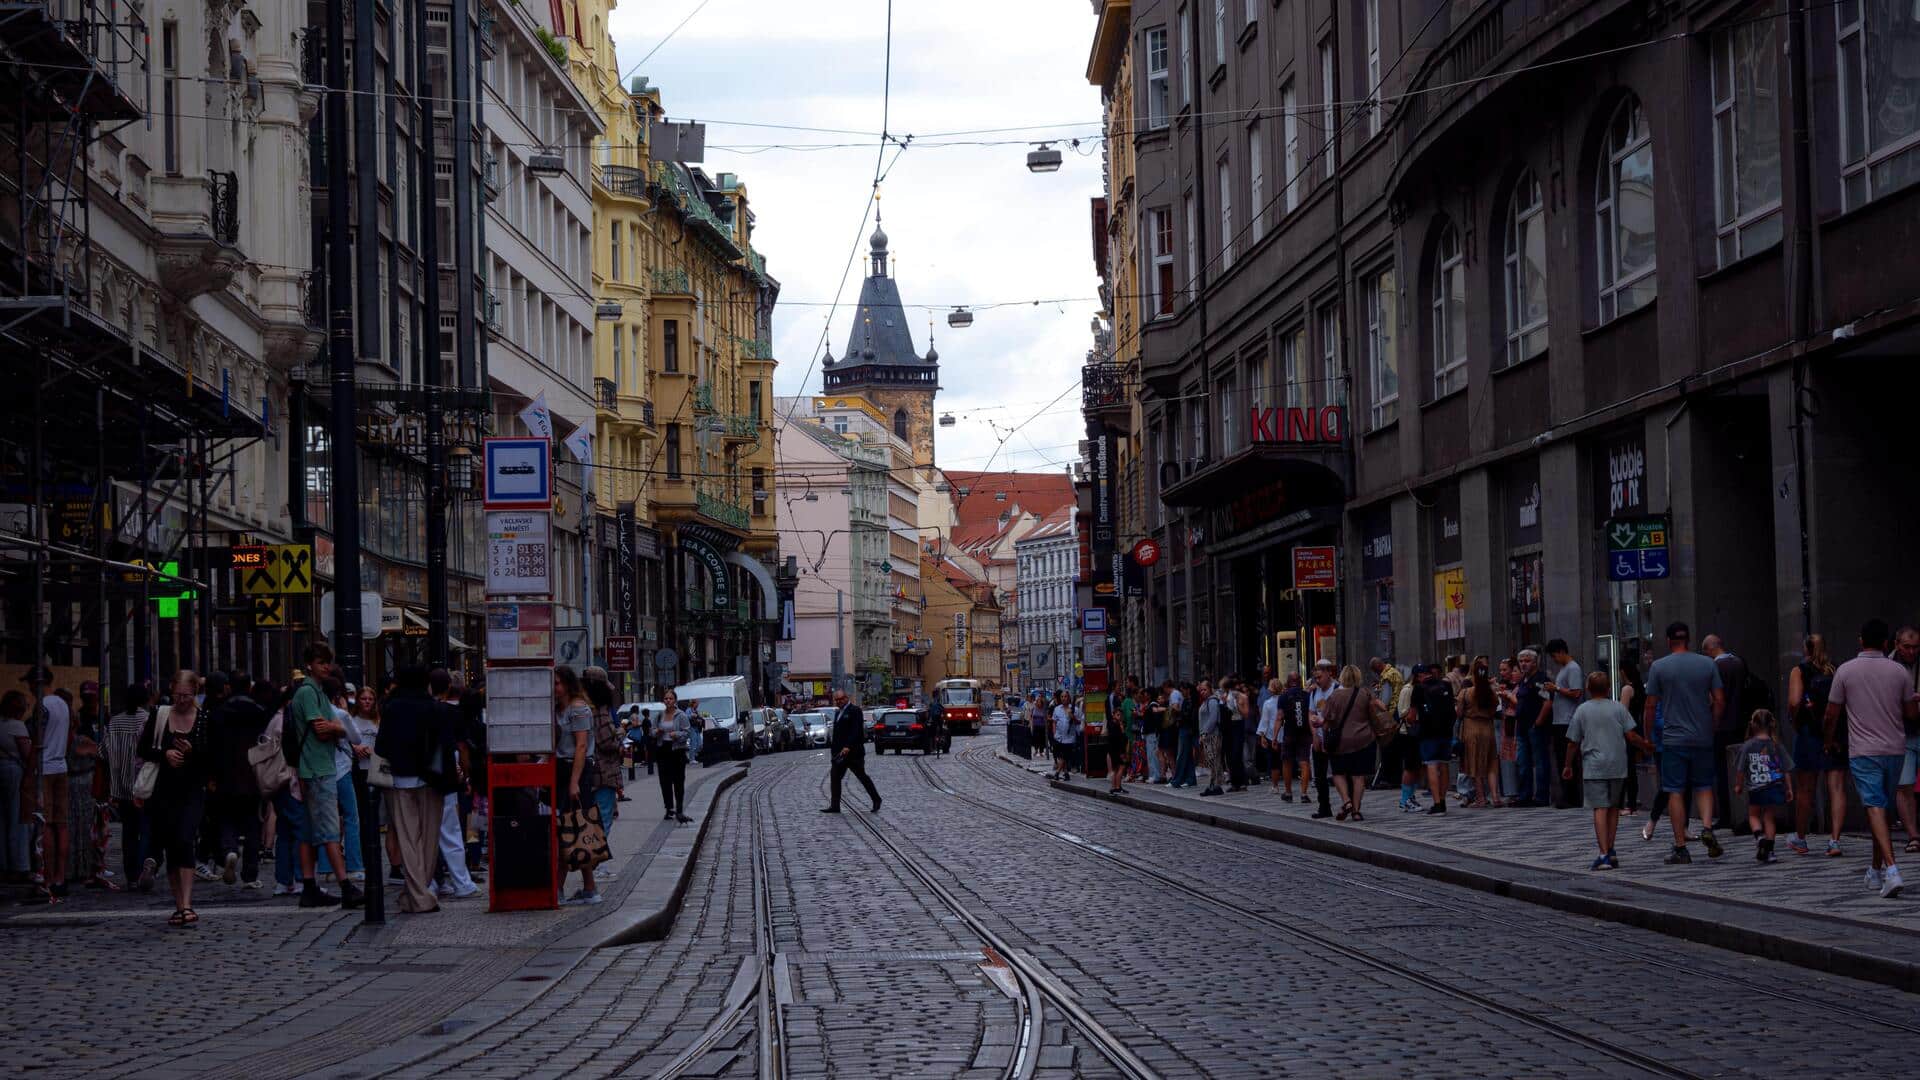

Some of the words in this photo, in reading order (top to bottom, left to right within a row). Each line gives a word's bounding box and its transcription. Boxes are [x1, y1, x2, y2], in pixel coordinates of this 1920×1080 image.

[1251, 406, 1344, 442] KINO
[1610, 443, 1645, 484] bubble
[1642, 534, 1650, 544] A
[1652, 533, 1662, 543] B
[507, 545, 514, 555] 9
[519, 545, 531, 555] 91
[532, 545, 545, 555] 95
[504, 556, 516, 566] 14
[519, 556, 531, 566] 92
[532, 556, 545, 566] 96
[504, 566, 516, 576] 24
[519, 566, 531, 576] 94
[532, 566, 545, 576] 98
[706, 553, 726, 591] COFFEE
[609, 641, 633, 649] NAILS
